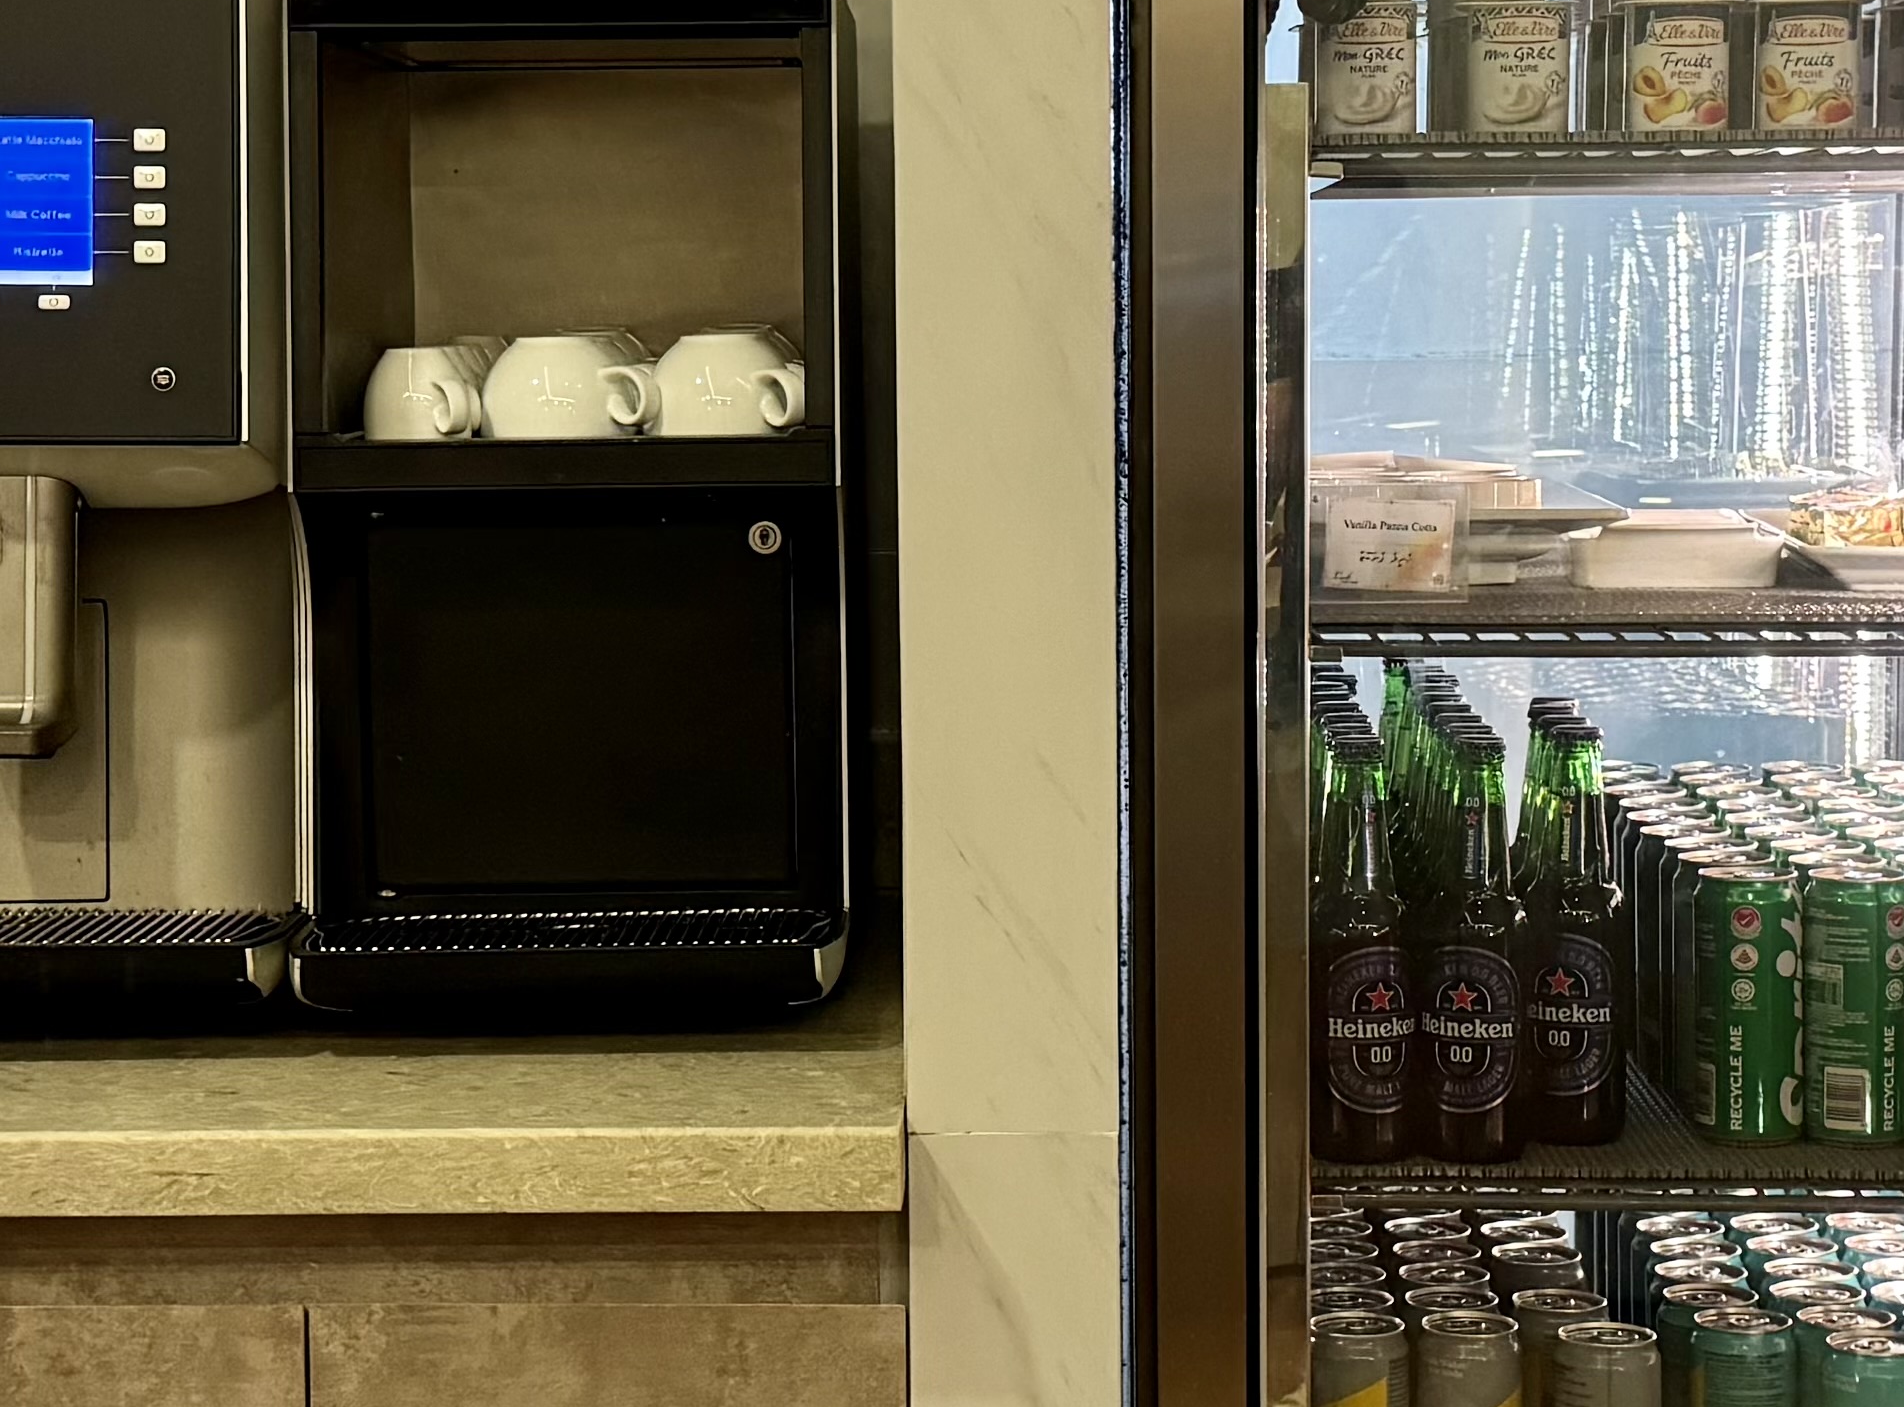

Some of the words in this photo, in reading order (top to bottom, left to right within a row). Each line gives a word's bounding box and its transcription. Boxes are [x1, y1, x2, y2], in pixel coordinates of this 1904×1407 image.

[1660, 51, 1713, 71] Fruits
[1780, 50, 1835, 71] Fruits
[1421, 1011, 1514, 1039] Heineken
[1526, 1000, 1611, 1023] eineken
[1730, 1025, 1744, 1053] ME
[1883, 1026, 1896, 1054] ME
[1730, 1057, 1744, 1132] RECYCLE
[1883, 1058, 1896, 1132] RECYCLE
